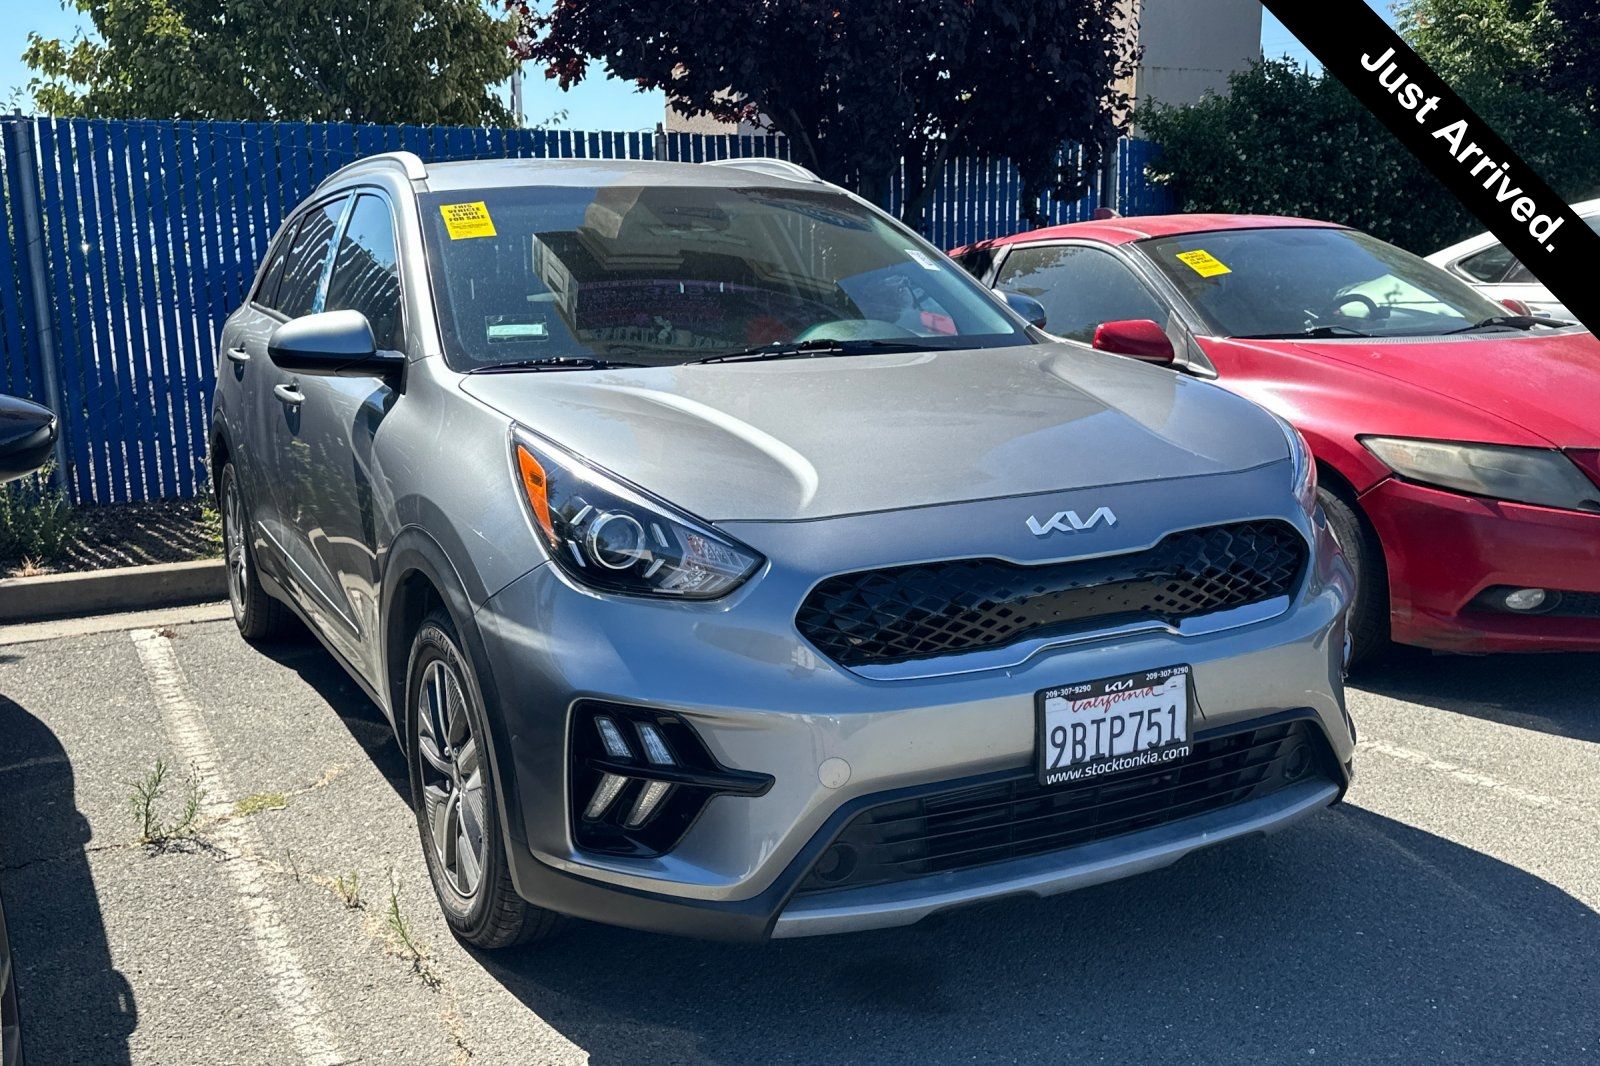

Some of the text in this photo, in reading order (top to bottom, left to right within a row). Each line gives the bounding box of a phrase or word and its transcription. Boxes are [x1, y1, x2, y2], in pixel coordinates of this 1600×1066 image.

[1025, 506, 1117, 535] KIA
[1104, 679, 1134, 693] KIA
[1146, 666, 1189, 681] 209-307-9290
[1045, 685, 1091, 698] 209-307-9290
[1071, 686, 1164, 713] California
[1050, 704, 1181, 769] 9BIP751
[1046, 746, 1190, 785] www.stocktonkia.com
